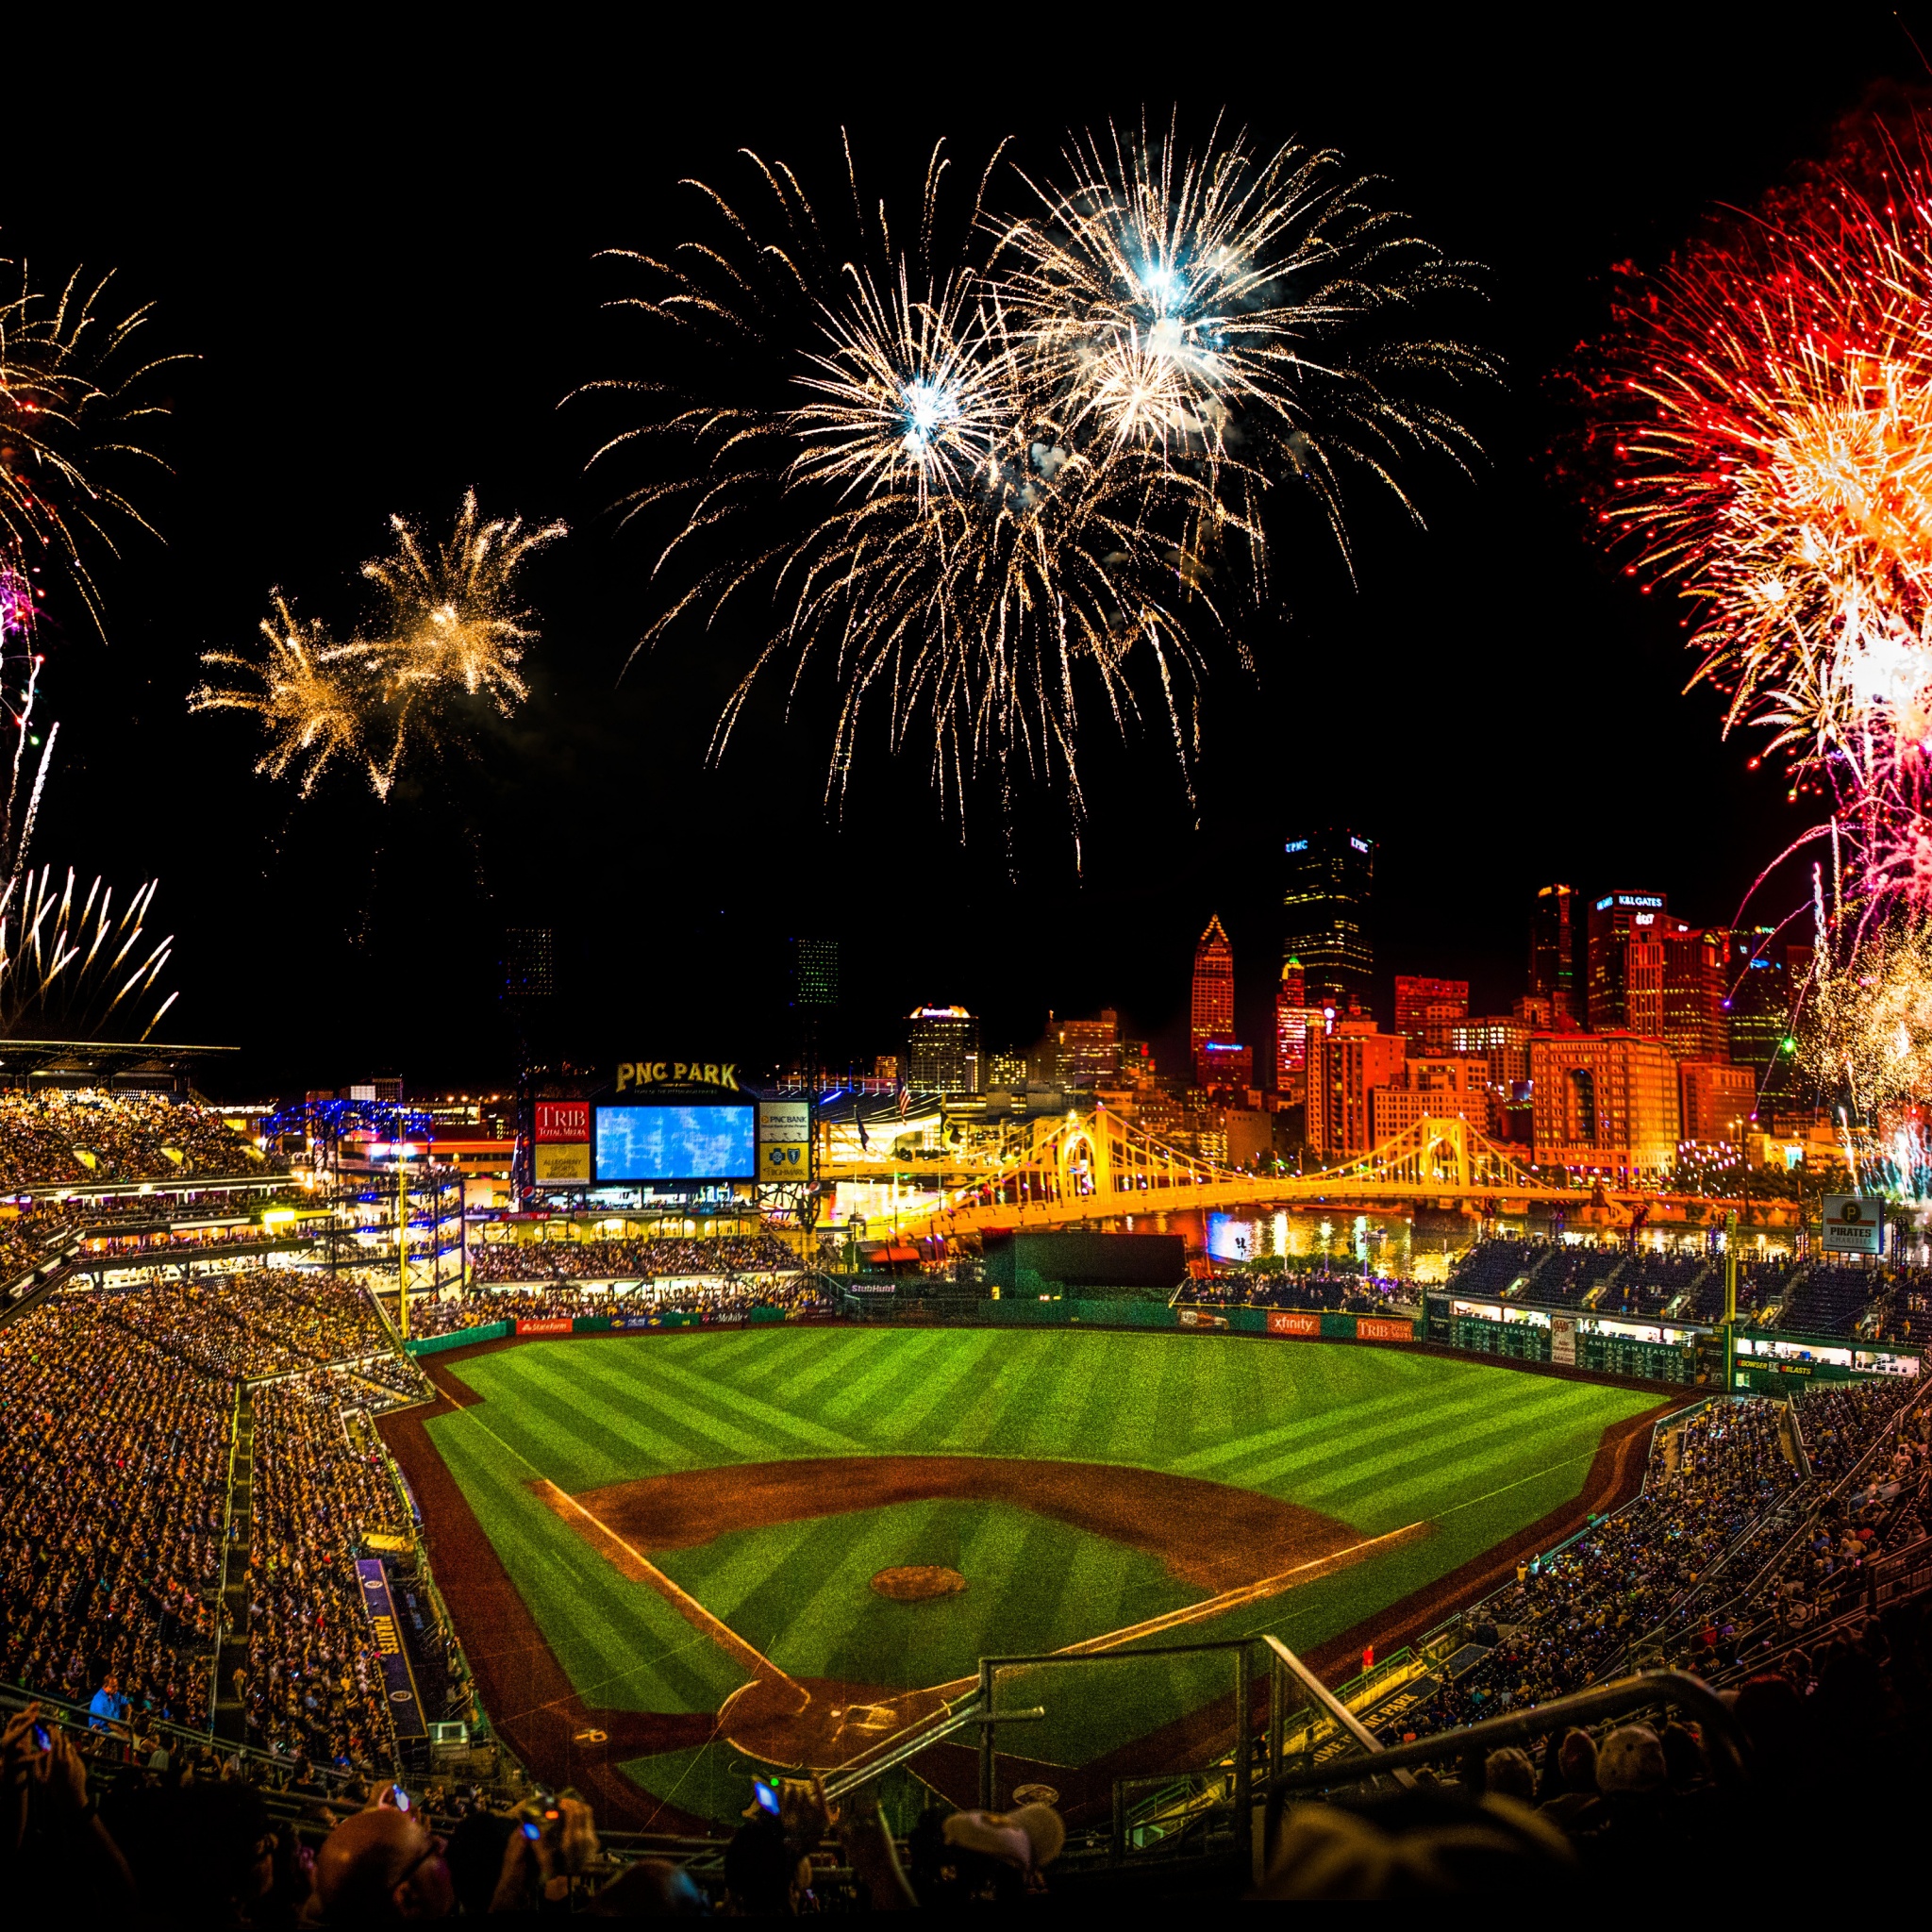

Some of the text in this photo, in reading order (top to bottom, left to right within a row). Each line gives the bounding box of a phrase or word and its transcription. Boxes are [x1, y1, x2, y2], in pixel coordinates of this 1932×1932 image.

[1636, 897, 1662, 908] GATES
[616, 1062, 740, 1092] PNC PARK
[537, 1107, 586, 1126] TRIB
[539, 1127, 562, 1137] TOTAL
[1830, 1227, 1872, 1238] PIRATES
[1830, 1237, 1872, 1245] CHARITIES
[852, 1284, 895, 1292] StubHub!
[1274, 1317, 1313, 1332] xfinity
[1358, 1322, 1389, 1338] TRIB
[1458, 1321, 1537, 1338] NATIONAL LEAGUE
[1588, 1340, 1639, 1352] AMERICAN
[1641, 1346, 1680, 1357] LEAGUE
[1740, 1359, 1811, 1374] BOWSER BLASTS
[373, 1615, 400, 1655] PIRATES
[1361, 1713, 1387, 1728] NC
[1378, 1693, 1419, 1716] PARK
